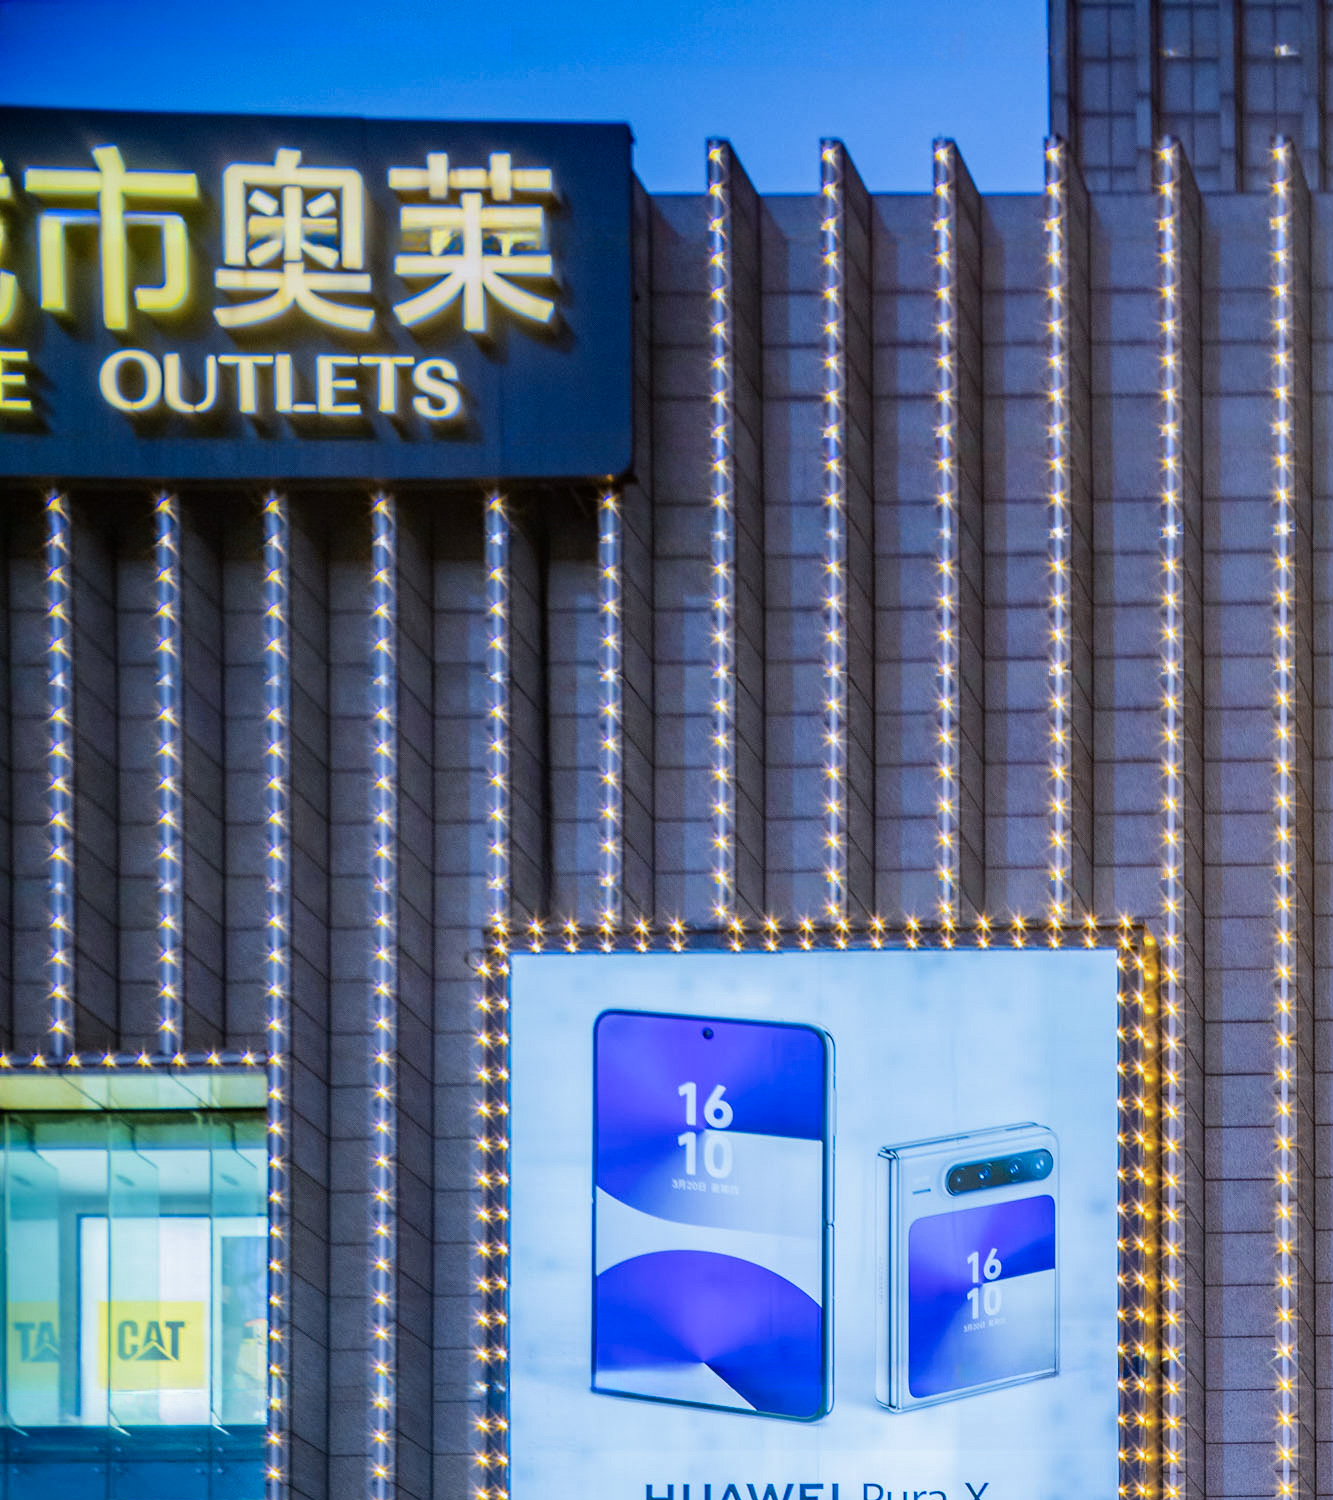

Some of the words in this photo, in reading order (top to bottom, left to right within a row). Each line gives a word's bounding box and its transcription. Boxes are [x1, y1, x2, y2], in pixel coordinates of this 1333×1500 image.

[0, 143, 555, 333] 市奥莱
[98, 349, 461, 420] OUTLETS
[678, 1081, 734, 1129] 16
[677, 1131, 734, 1179] 10
[966, 1247, 1003, 1284] 16
[966, 1286, 1003, 1320] 10
[116, 1320, 186, 1362] CAT
